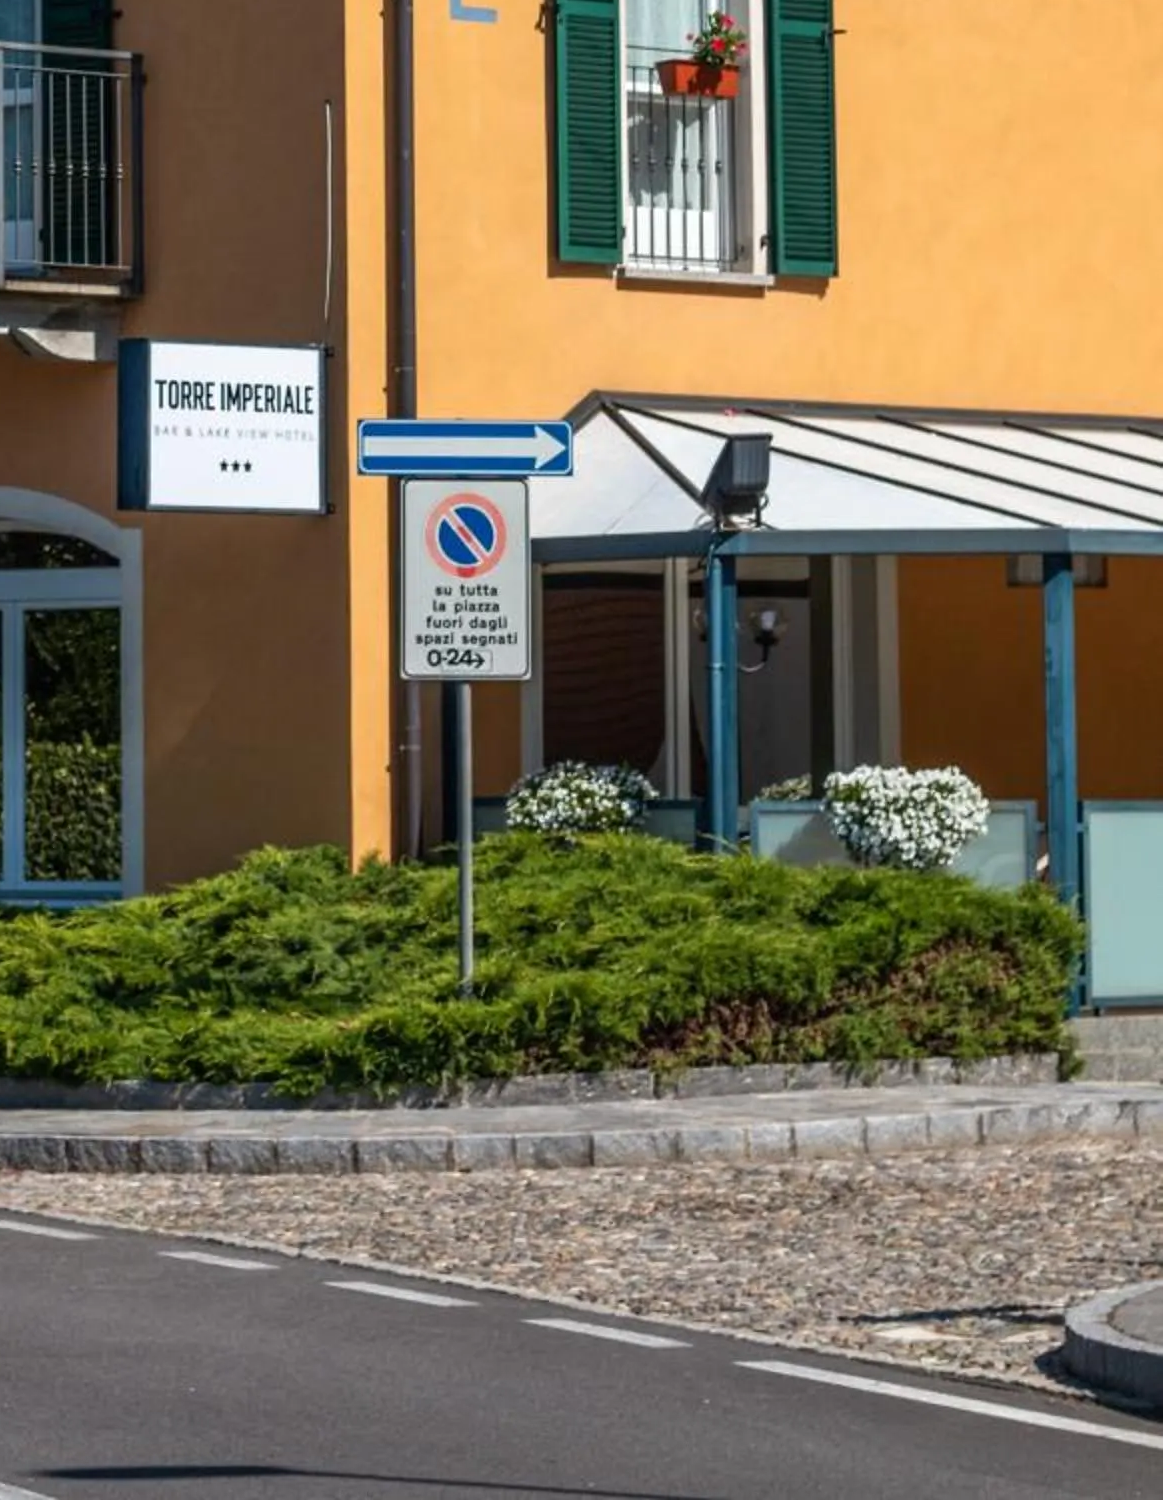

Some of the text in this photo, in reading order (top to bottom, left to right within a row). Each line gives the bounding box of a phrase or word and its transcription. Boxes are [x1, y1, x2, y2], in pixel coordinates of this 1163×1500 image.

[154, 379, 314, 414] TORRE IMPERIALE
[154, 424, 178, 437] BAR
[198, 427, 230, 439] LAKE
[237, 428, 269, 440] VIEW
[275, 430, 315, 442] HOTEL
[434, 584, 499, 597] su tutta
[432, 599, 500, 614] la piazza
[425, 615, 508, 632] fuori dagli
[415, 631, 518, 646] spazi segnati
